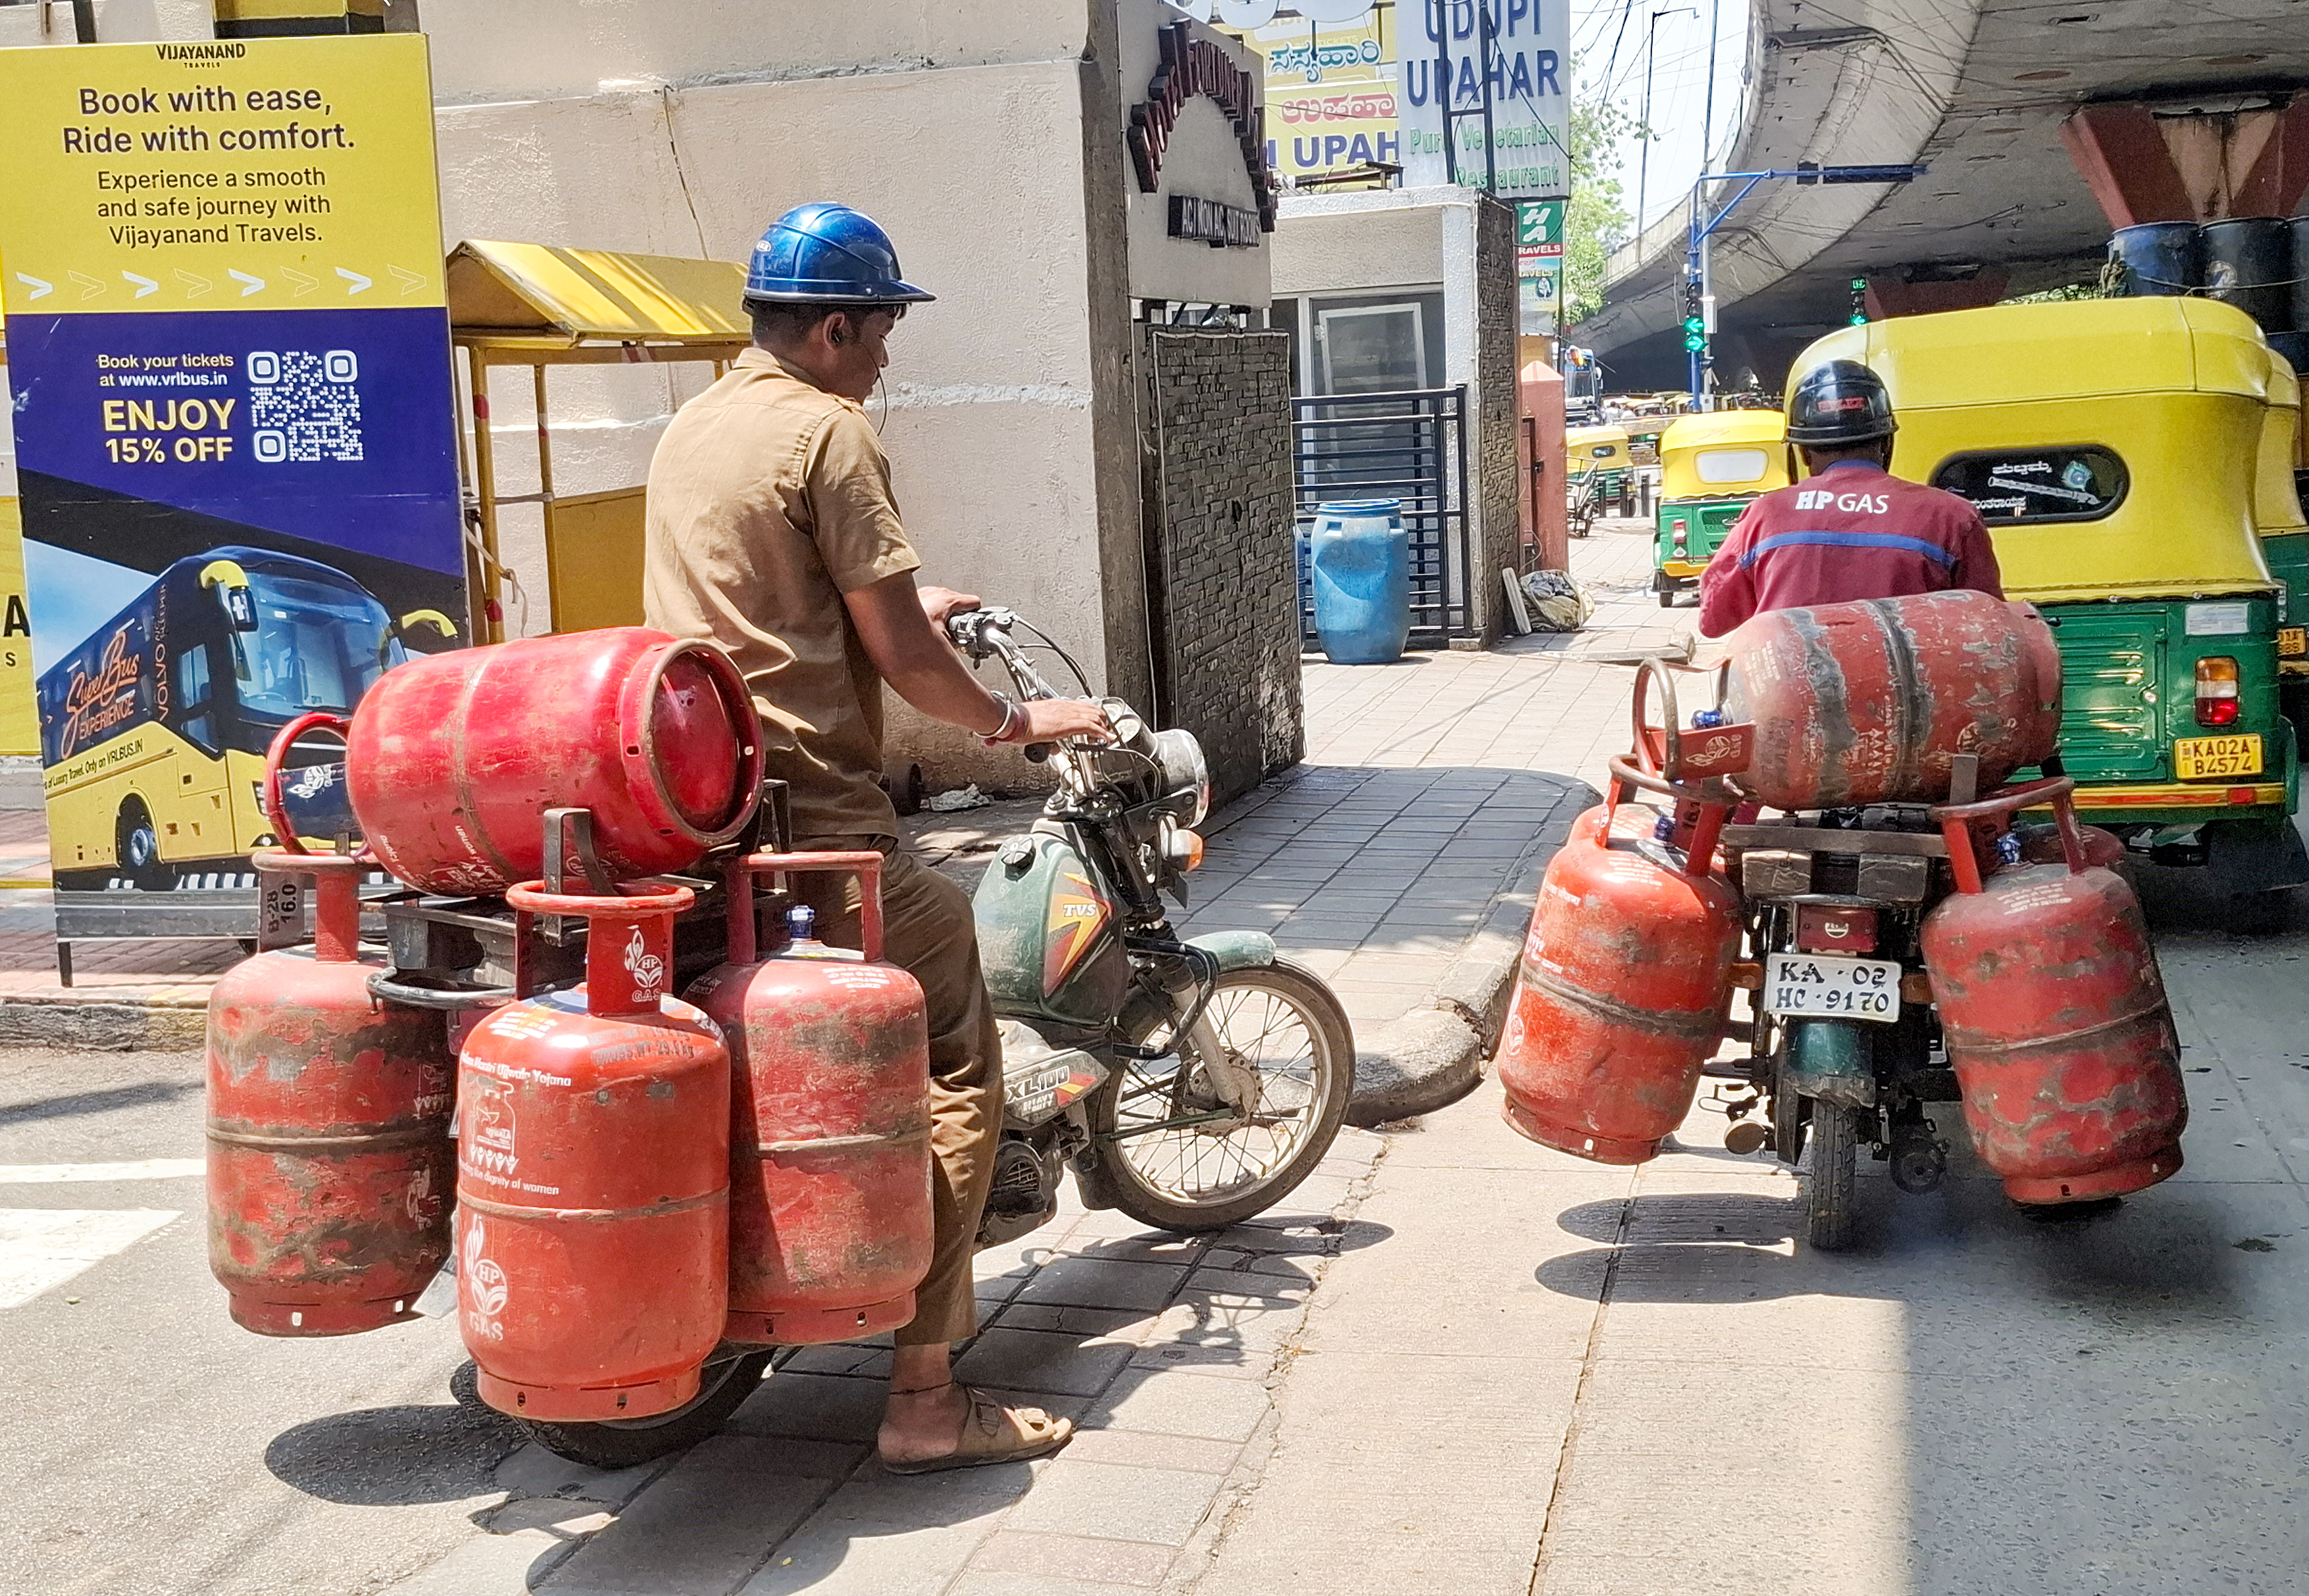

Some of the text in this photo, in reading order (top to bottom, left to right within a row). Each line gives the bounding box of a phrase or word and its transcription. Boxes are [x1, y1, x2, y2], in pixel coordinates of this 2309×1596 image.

[156, 43, 246, 60] VIJAYANAND
[1407, 50, 1561, 107] UPAHAR
[80, 85, 330, 115] Book with ease,
[64, 122, 354, 153] Ride with comfort.
[1294, 132, 1398, 167] UPAH
[1410, 120, 1559, 154] Pur Veetarian
[99, 167, 325, 193] Experience a smooth
[1455, 164, 1559, 190] Resaurant
[99, 194, 330, 220] and safe journey with
[109, 223, 321, 249] Vijayanand Travels.
[99, 353, 233, 370] Book your tickets
[100, 371, 227, 386] at www.vrlbus.in
[104, 399, 235, 431] ENJOY
[106, 438, 232, 463] 15% OFF
[1795, 490, 1889, 514] HP GAS
[155, 644, 169, 721] VOLVO
[79, 697, 135, 740] EXPERIENCE
[2193, 739, 2250, 757] KA02A
[2195, 756, 2251, 775] B4574
[1064, 904, 1096, 917] TVS
[642, 959, 658, 969] HP
[1779, 962, 1825, 983] KA
[1776, 988, 1889, 1012] HC 9170
[512, 1178, 521, 1189] of
[523, 1183, 559, 1195] women
[480, 1264, 500, 1284] HP
[469, 1310, 503, 1341] GAS
